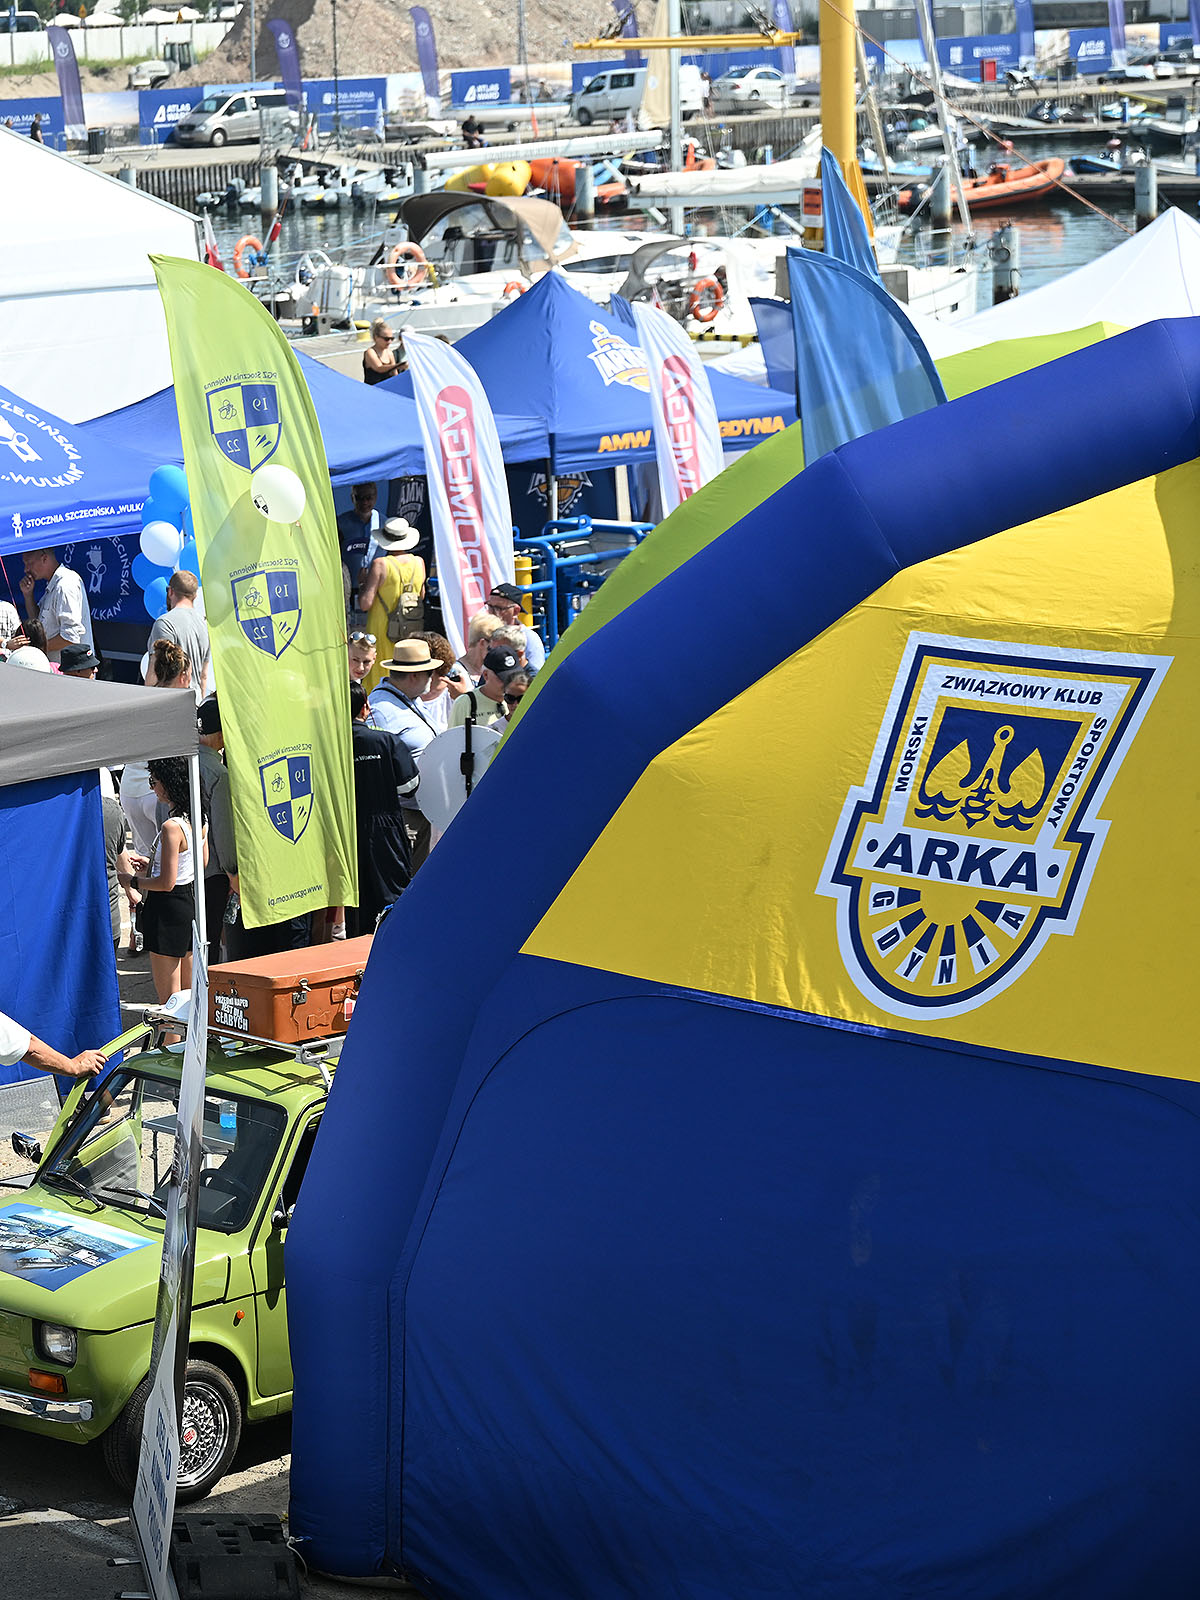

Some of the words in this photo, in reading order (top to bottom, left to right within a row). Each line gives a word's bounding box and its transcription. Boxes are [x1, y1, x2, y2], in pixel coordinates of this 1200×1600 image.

[166, 103, 191, 113] ATLAS
[598, 430, 652, 453] AMW
[719, 415, 786, 437] GDYNIA
[25, 514, 64, 528] STOCZNIA
[65, 505, 115, 521] SZCZECIŃSKA
[117, 502, 144, 515] „WULK
[940, 674, 1053, 701] ZWIĄZKOWY
[1054, 687, 1103, 706] KLUB
[895, 715, 928, 792] MORSKI
[1046, 716, 1108, 829] SPORTOWY
[872, 833, 1039, 892] ARKA
[872, 889, 1026, 984] GDYNIA
[215, 1010, 248, 1031] SŁABYCH
[221, 1003, 233, 1014] JEST
